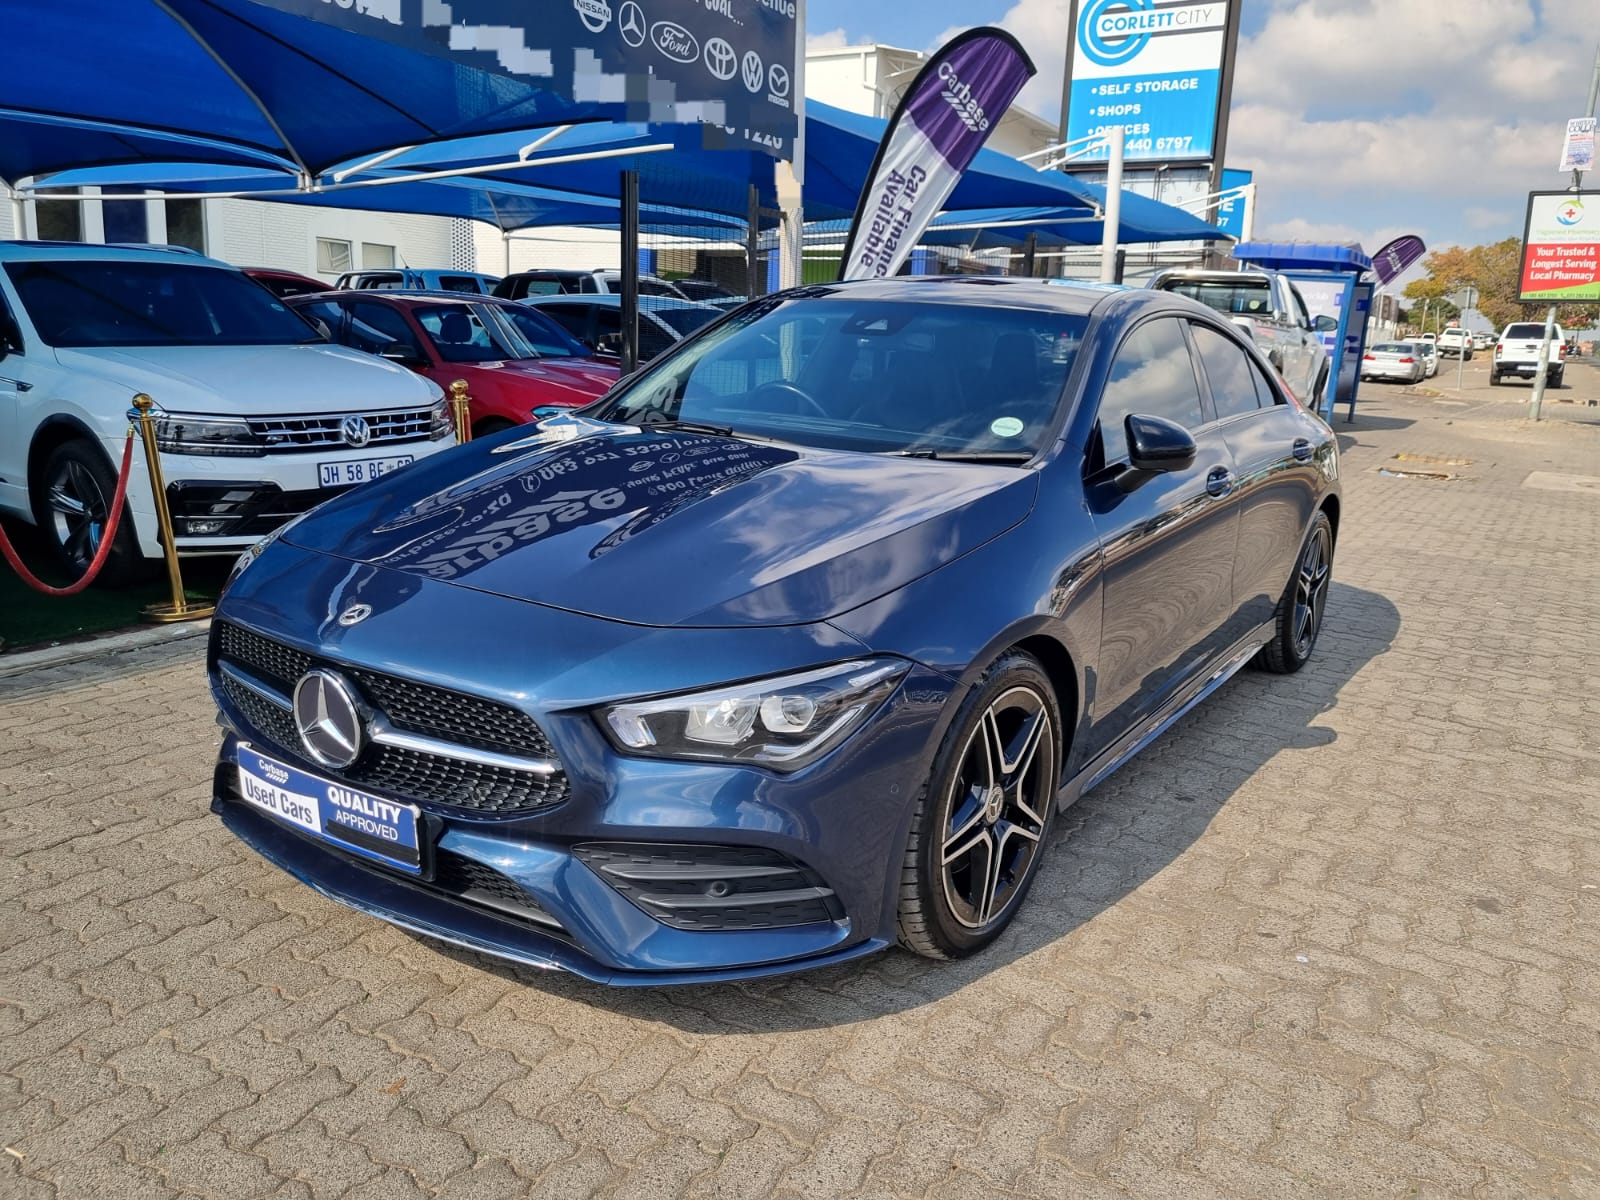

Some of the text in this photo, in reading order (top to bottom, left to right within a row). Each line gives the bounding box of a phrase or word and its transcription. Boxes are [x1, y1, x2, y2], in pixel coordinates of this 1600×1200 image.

[660, 27, 690, 56] Ford
[938, 61, 990, 132] Carbase
[1099, 79, 1199, 95] SELF STORAGE
[1097, 104, 1141, 117] SHOPS
[1125, 138, 1152, 150] 440
[1156, 136, 1192, 150] 6797
[903, 165, 926, 203] Car
[860, 169, 906, 267] Available
[874, 206, 912, 278] Financ
[1537, 247, 1554, 256] Your
[1556, 247, 1587, 256] Trusted
[1530, 270, 1595, 282] Local Pharmacy
[1531, 259, 1597, 270] Longest Serving
[346, 464, 363, 481] 58
[258, 759, 289, 780] Carbase
[244, 777, 313, 825] Used Cars
[327, 786, 402, 825] QUALITY
[335, 809, 398, 841] APPROVED
